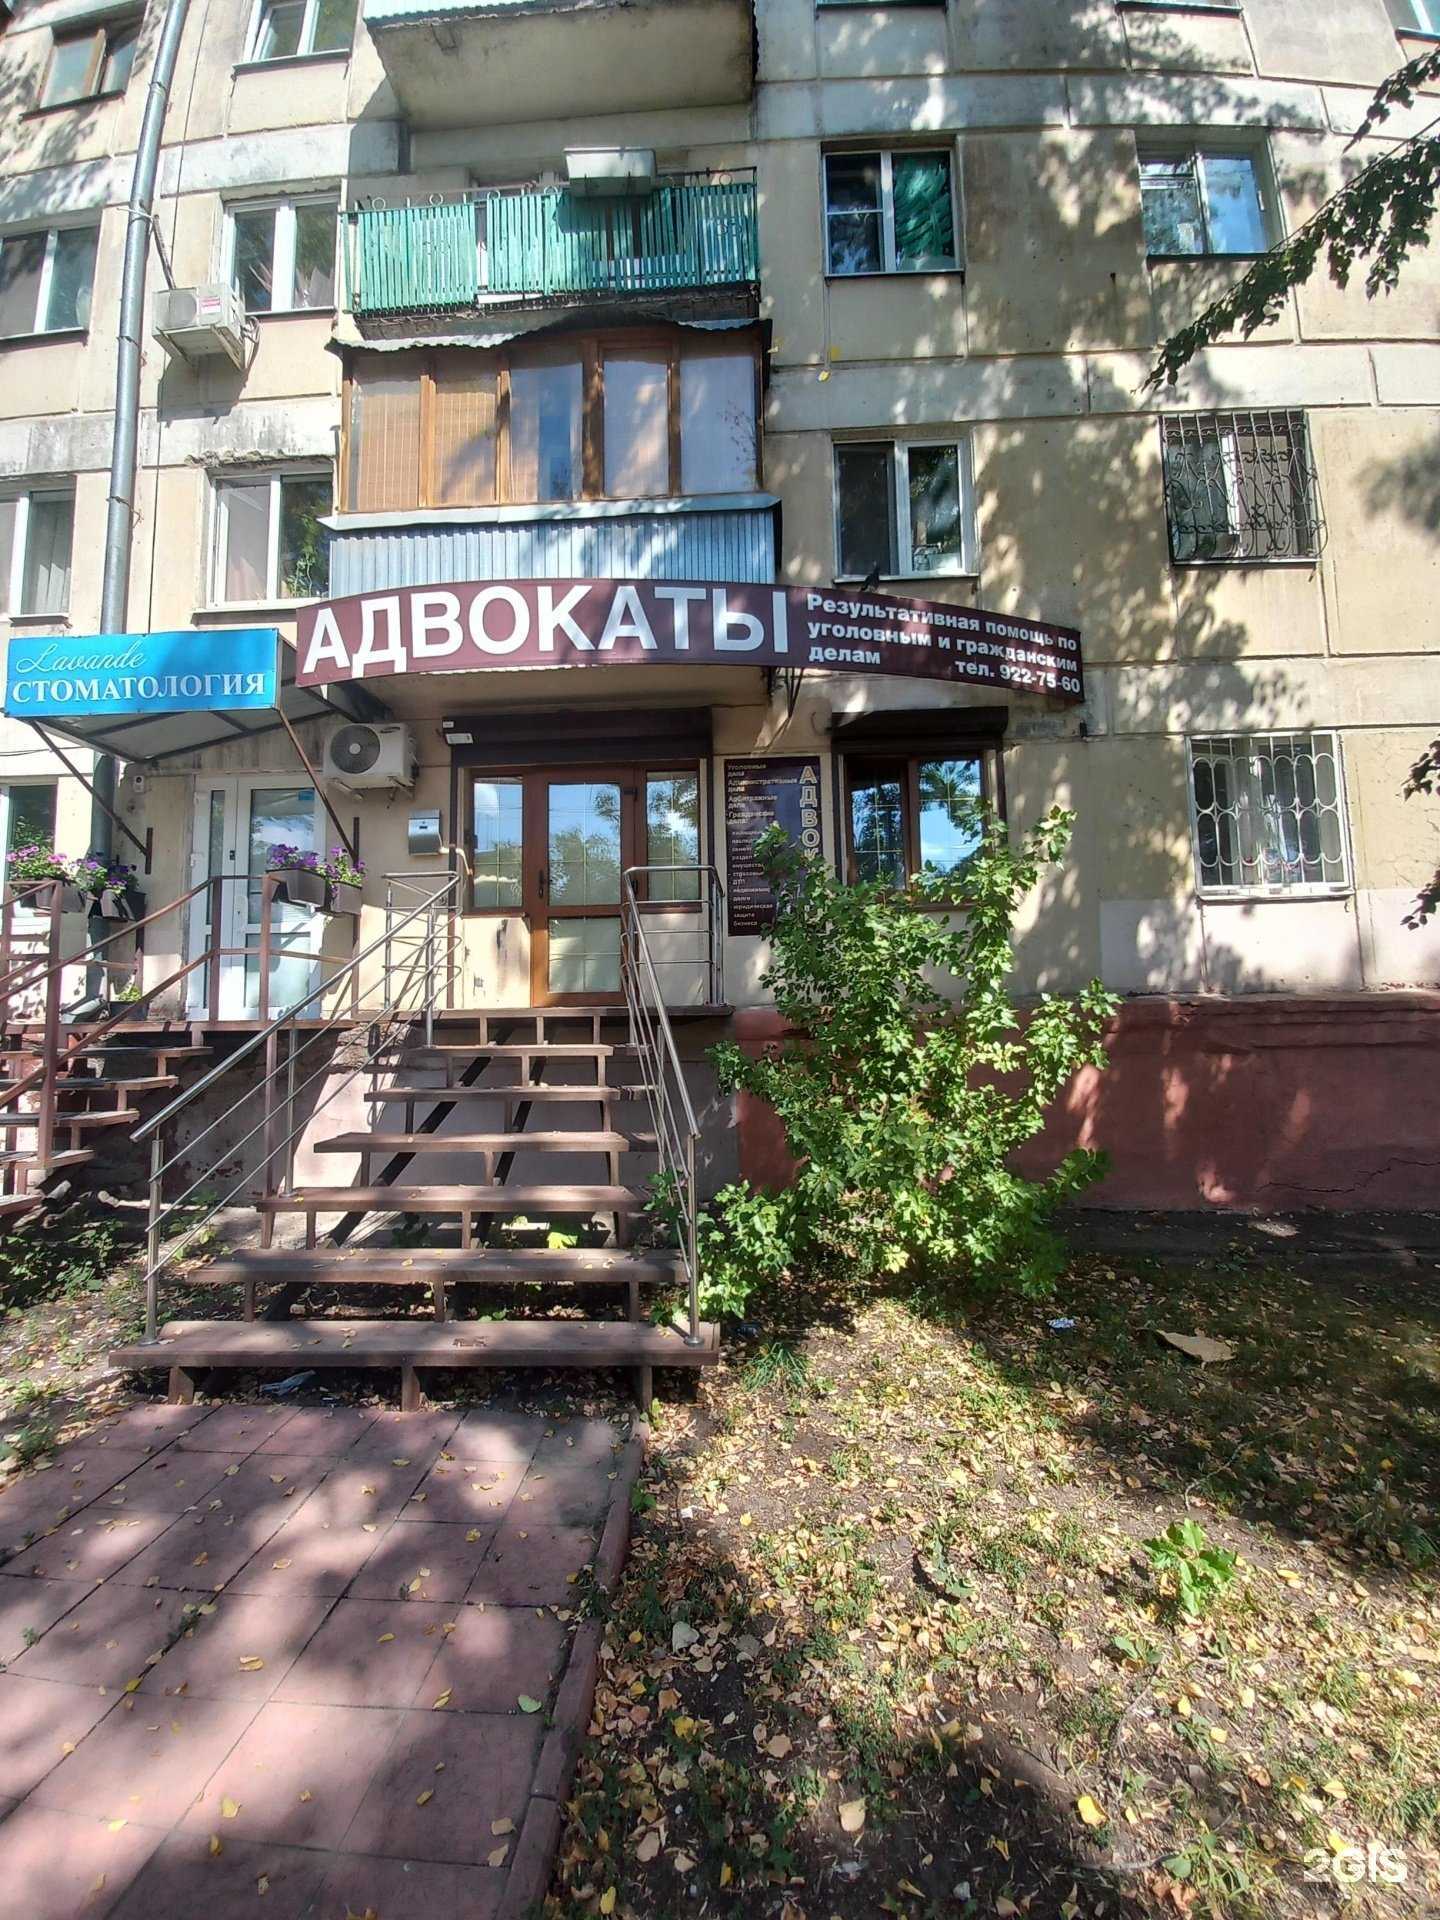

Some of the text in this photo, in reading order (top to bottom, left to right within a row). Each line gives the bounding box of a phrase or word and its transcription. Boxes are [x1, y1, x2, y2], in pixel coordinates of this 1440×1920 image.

[303, 585, 788, 677] АДВОКАТЫ
[806, 593, 1077, 651] Результативная помощь по
[16, 640, 147, 673] Lavande
[808, 621, 1078, 672] уголовным и гражданским
[809, 646, 881, 665] делам
[13, 673, 265, 703] СТОМАТОЛОГИЯ
[955, 659, 1080, 693] тел. 922-75-60
